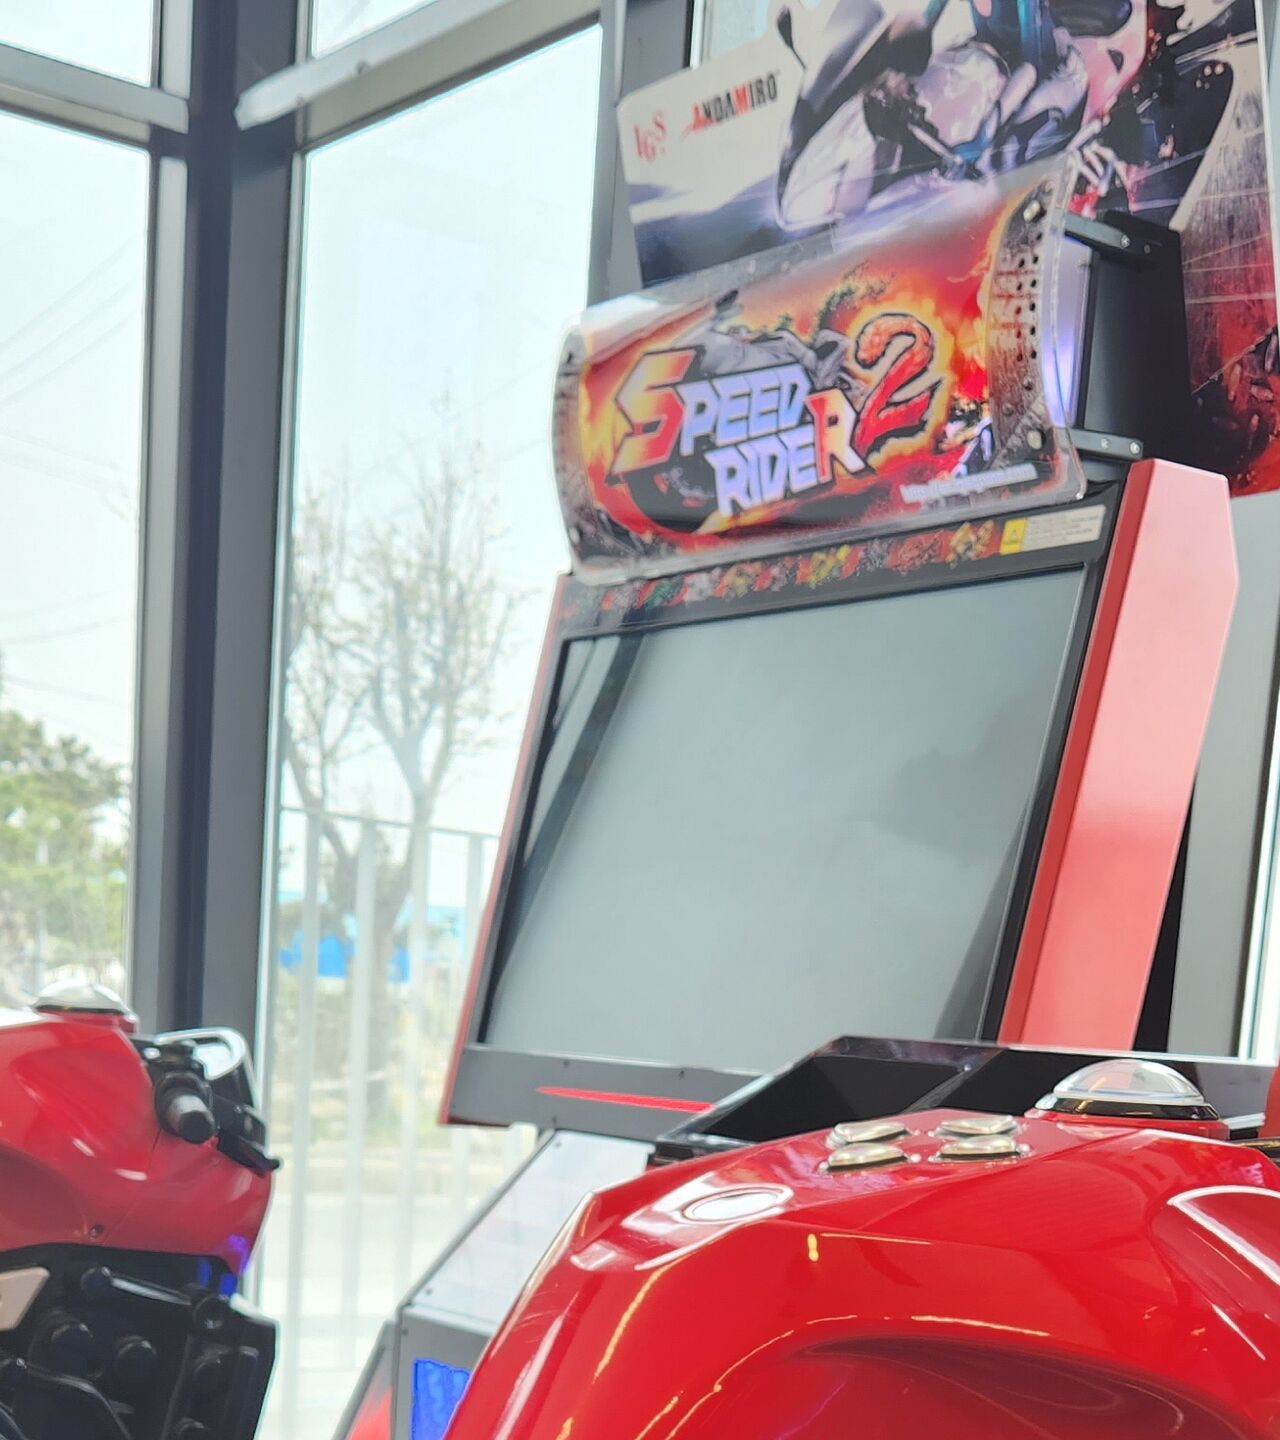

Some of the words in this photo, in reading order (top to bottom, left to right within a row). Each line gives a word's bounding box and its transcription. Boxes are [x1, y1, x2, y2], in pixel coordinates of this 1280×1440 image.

[684, 73, 778, 134] ANDAMIRO
[609, 348, 813, 476] SPEED
[704, 387, 866, 517] RIDER
[854, 313, 942, 457] 2
